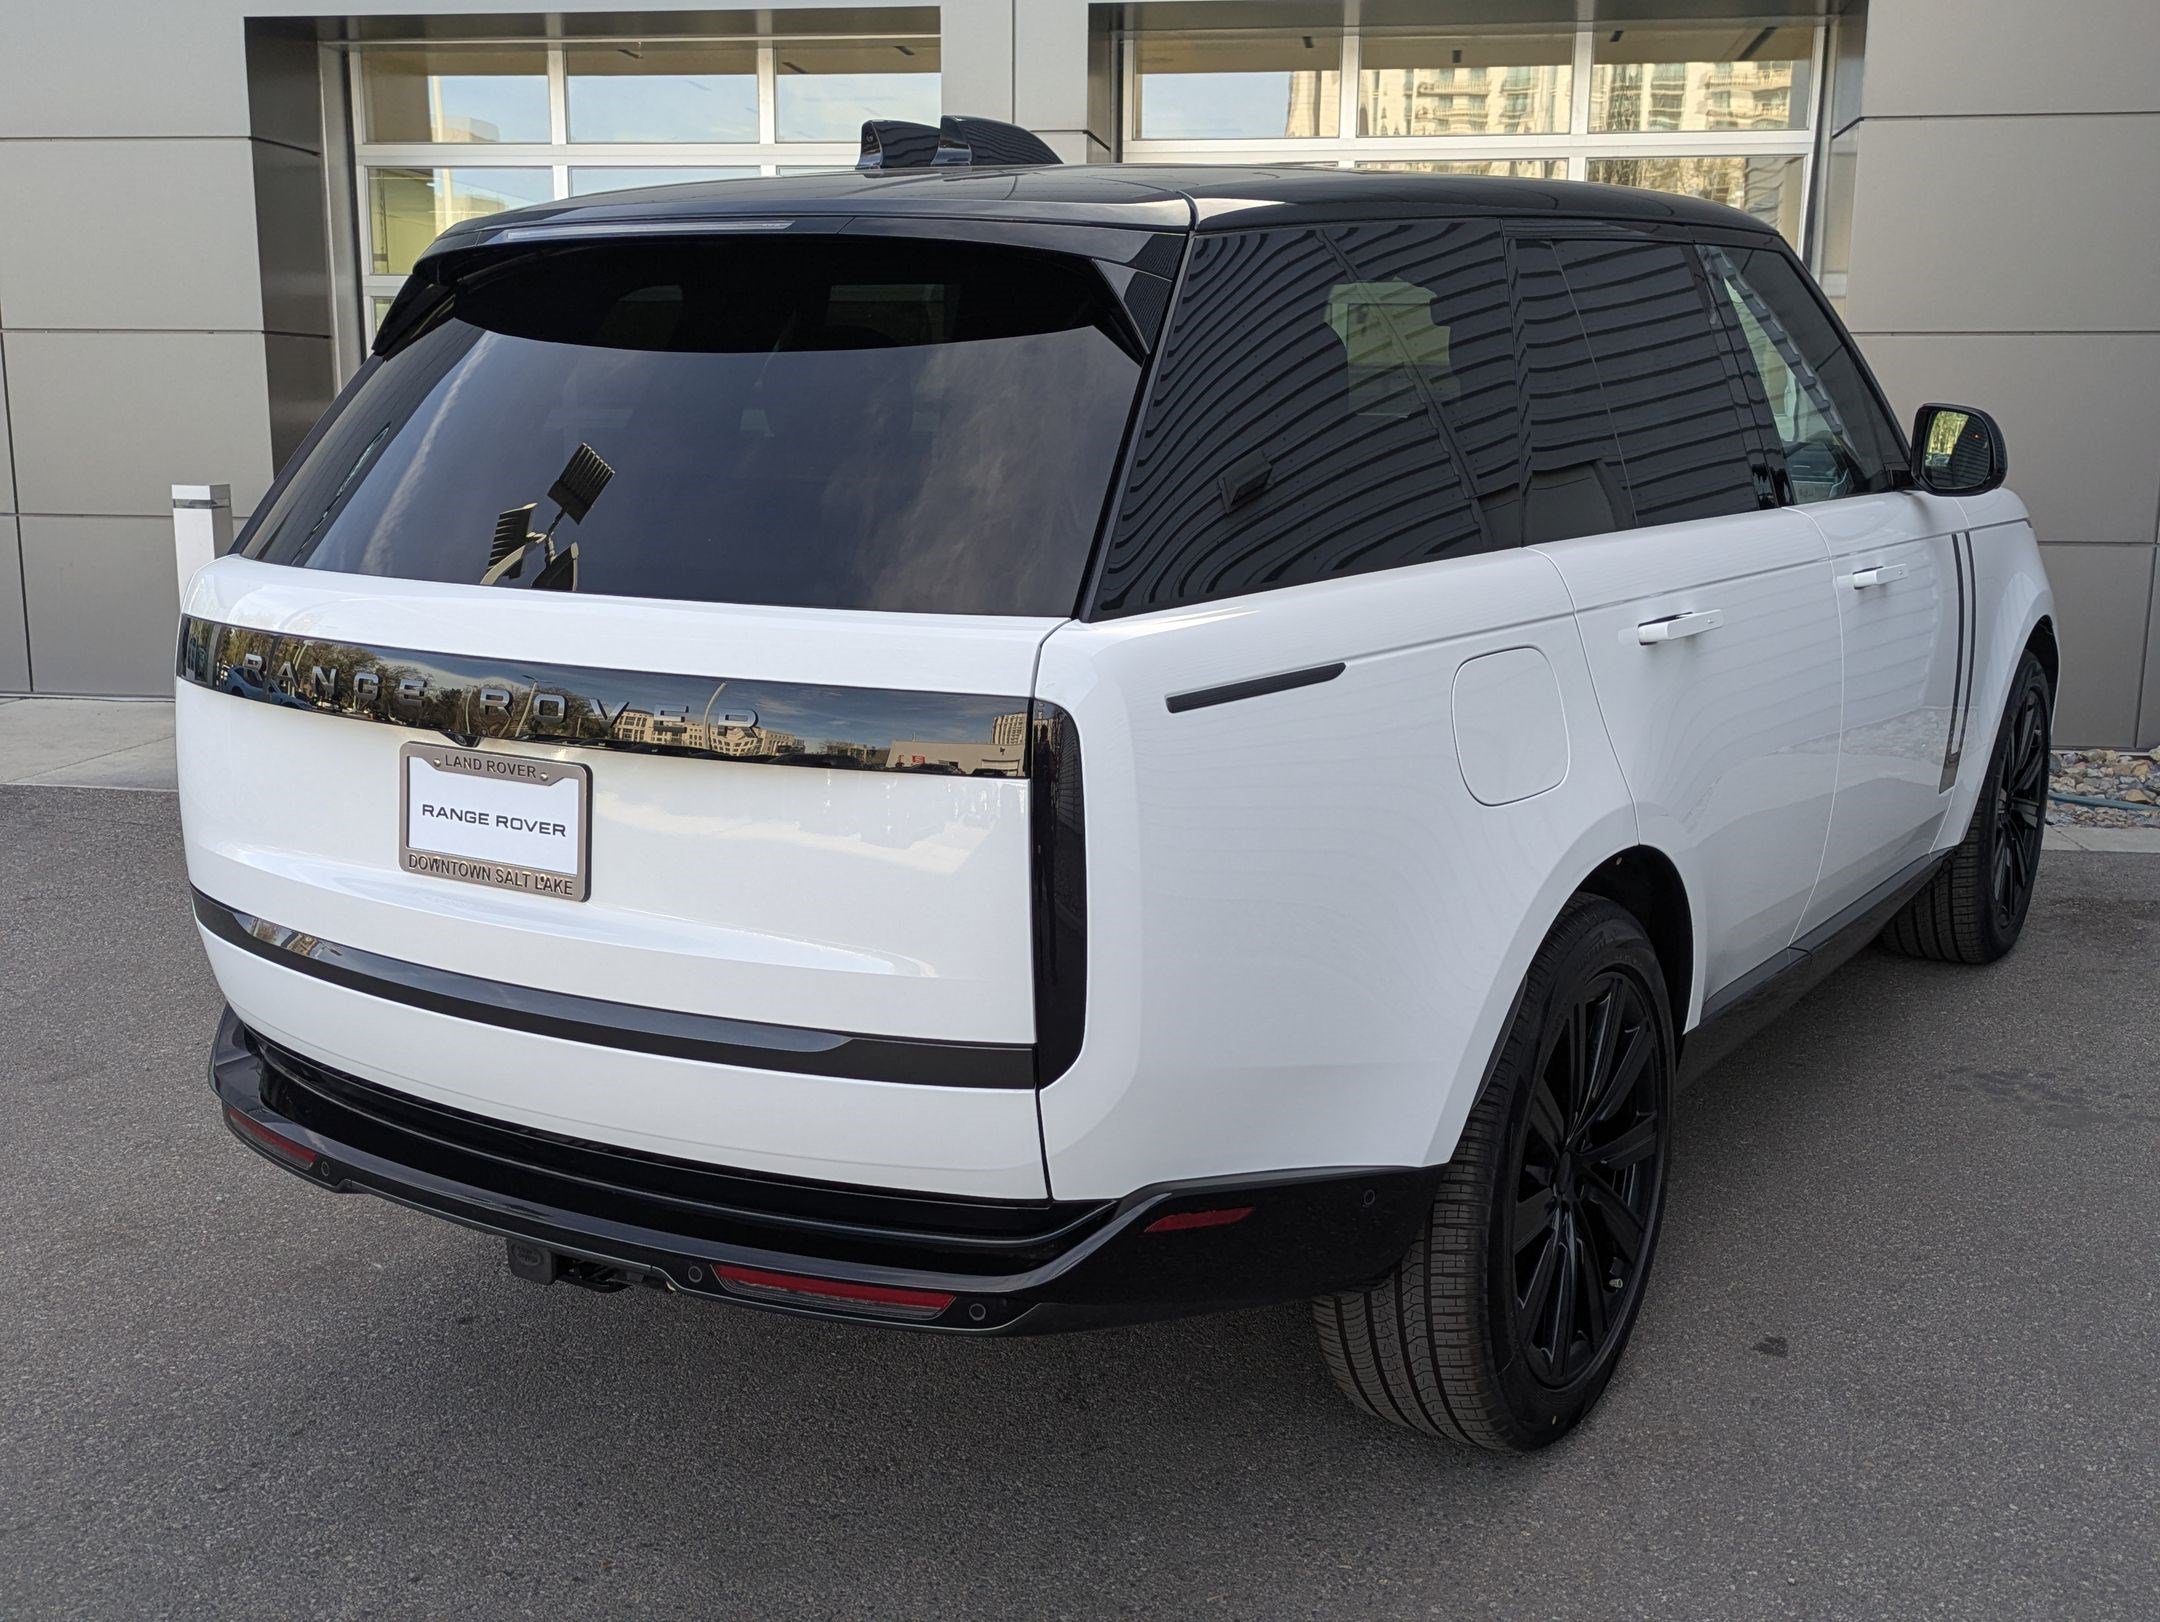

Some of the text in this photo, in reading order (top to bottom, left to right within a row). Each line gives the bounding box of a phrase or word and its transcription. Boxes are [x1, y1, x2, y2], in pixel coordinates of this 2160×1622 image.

[242, 653, 760, 737] RANGE ROVER
[445, 754, 537, 779] LAND ROVER
[422, 803, 567, 838] RANGE ROVER
[408, 854, 573, 896] DOWNTOWN SALT LAKE
